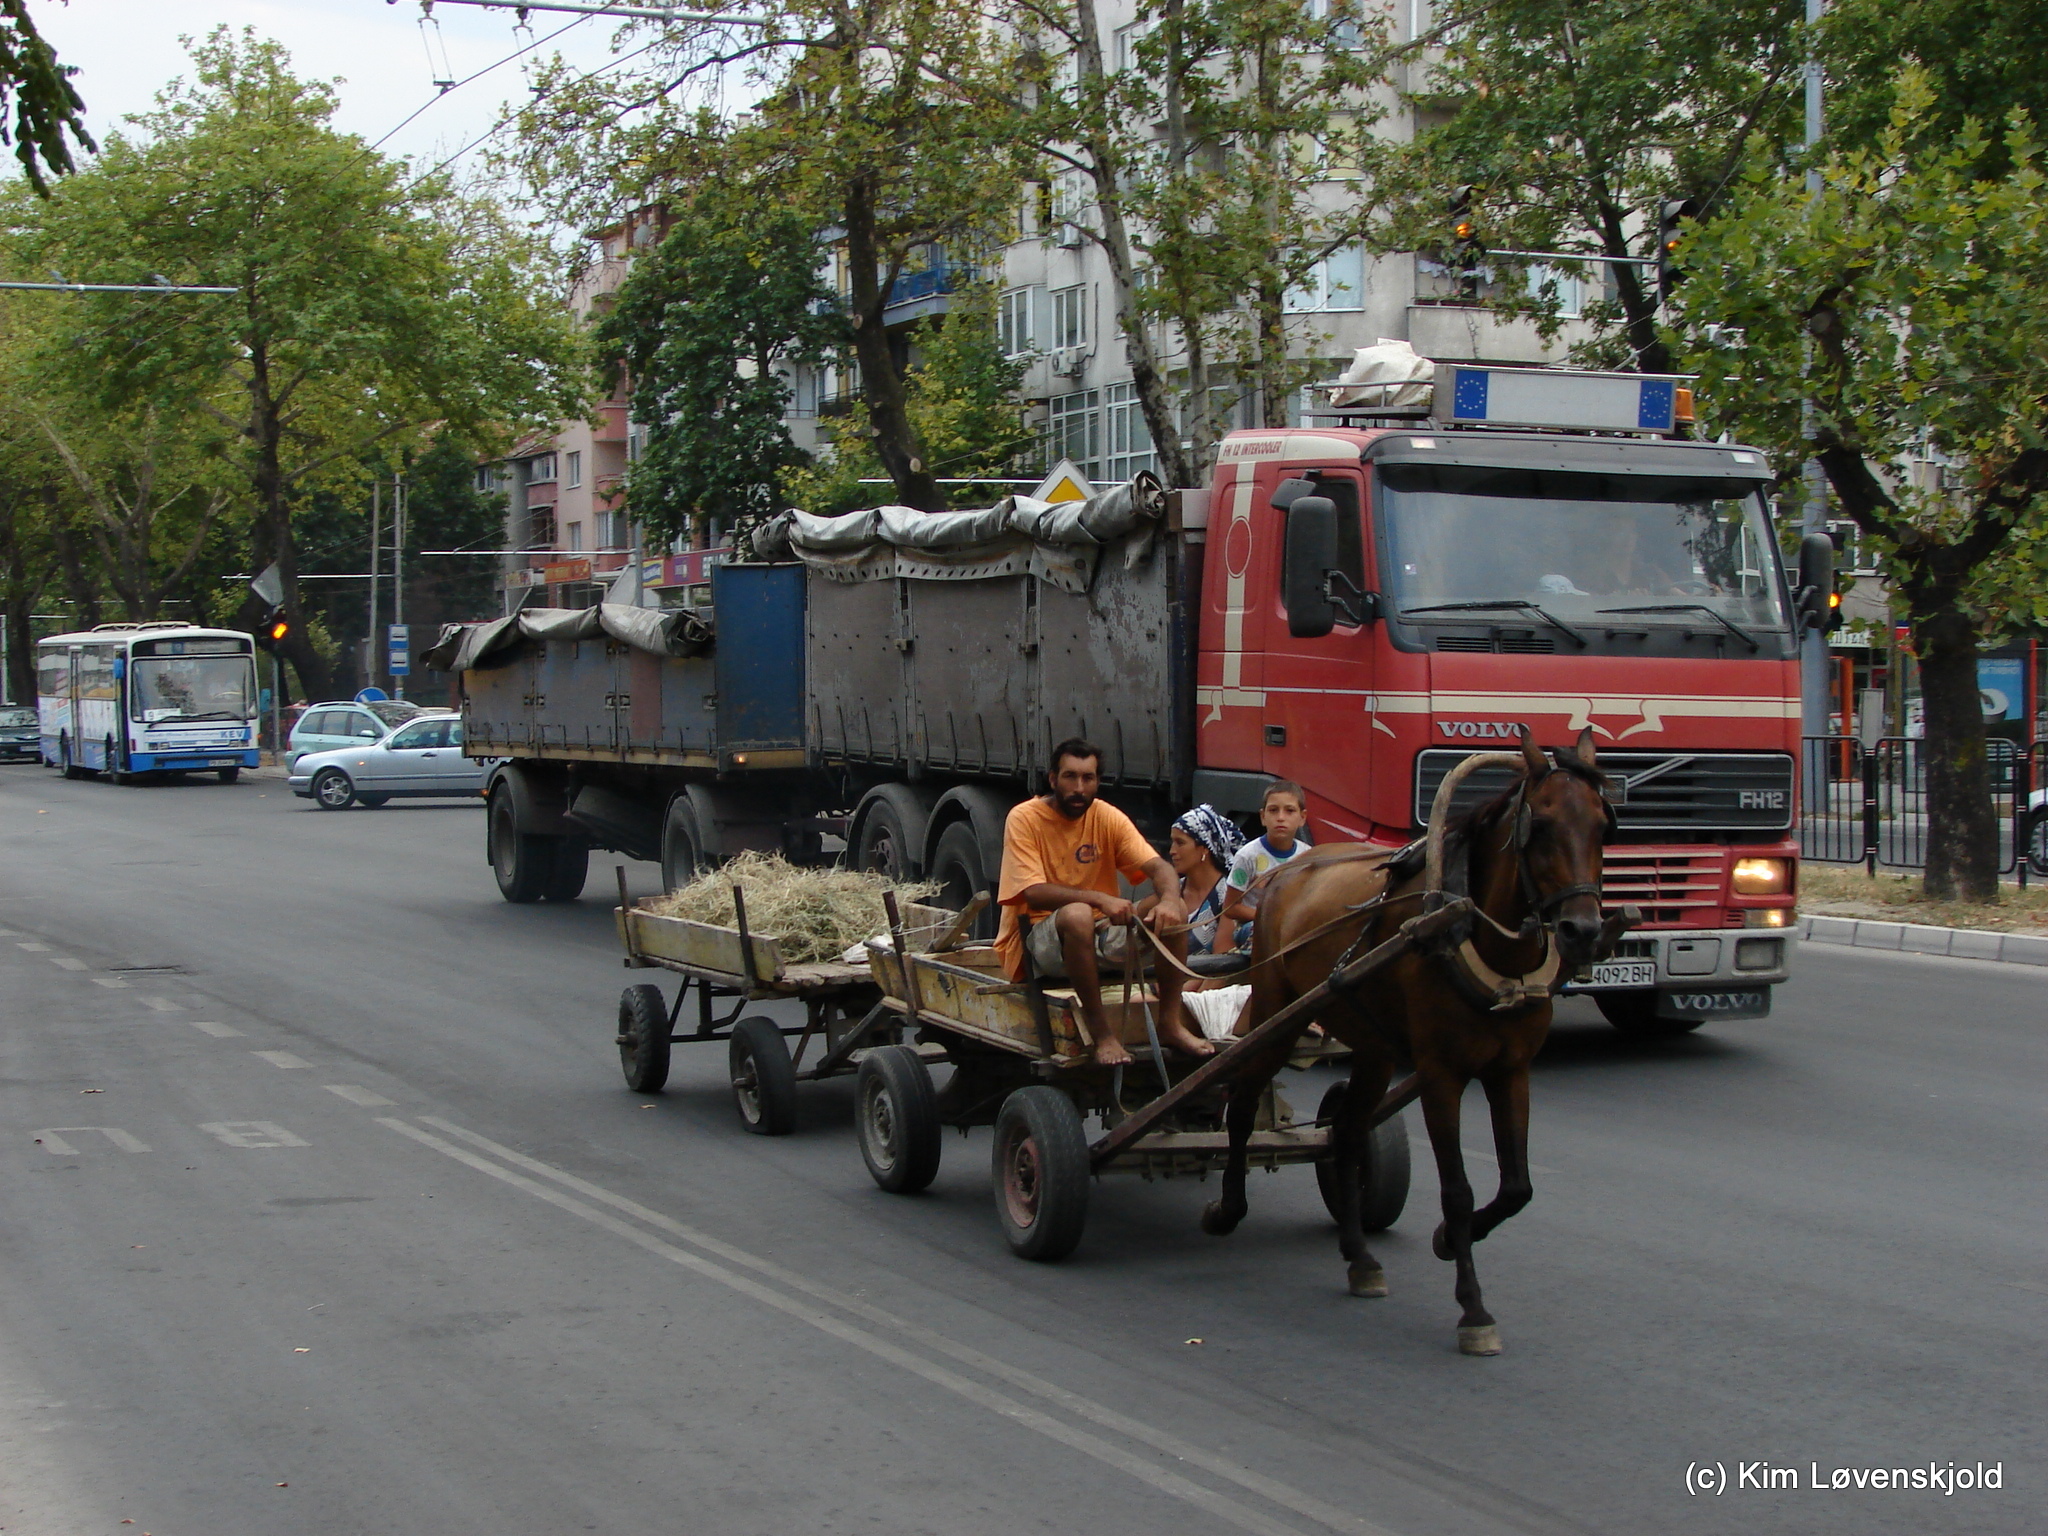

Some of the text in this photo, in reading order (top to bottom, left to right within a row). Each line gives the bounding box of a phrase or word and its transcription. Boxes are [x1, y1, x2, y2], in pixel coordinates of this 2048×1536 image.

[1233, 443, 1241, 456] 12
[1241, 441, 1283, 456] INTERCOOLER
[1437, 721, 1531, 738] VOLVO
[1739, 791, 1784, 809] FH12
[1670, 993, 1763, 1010] VOLVO
